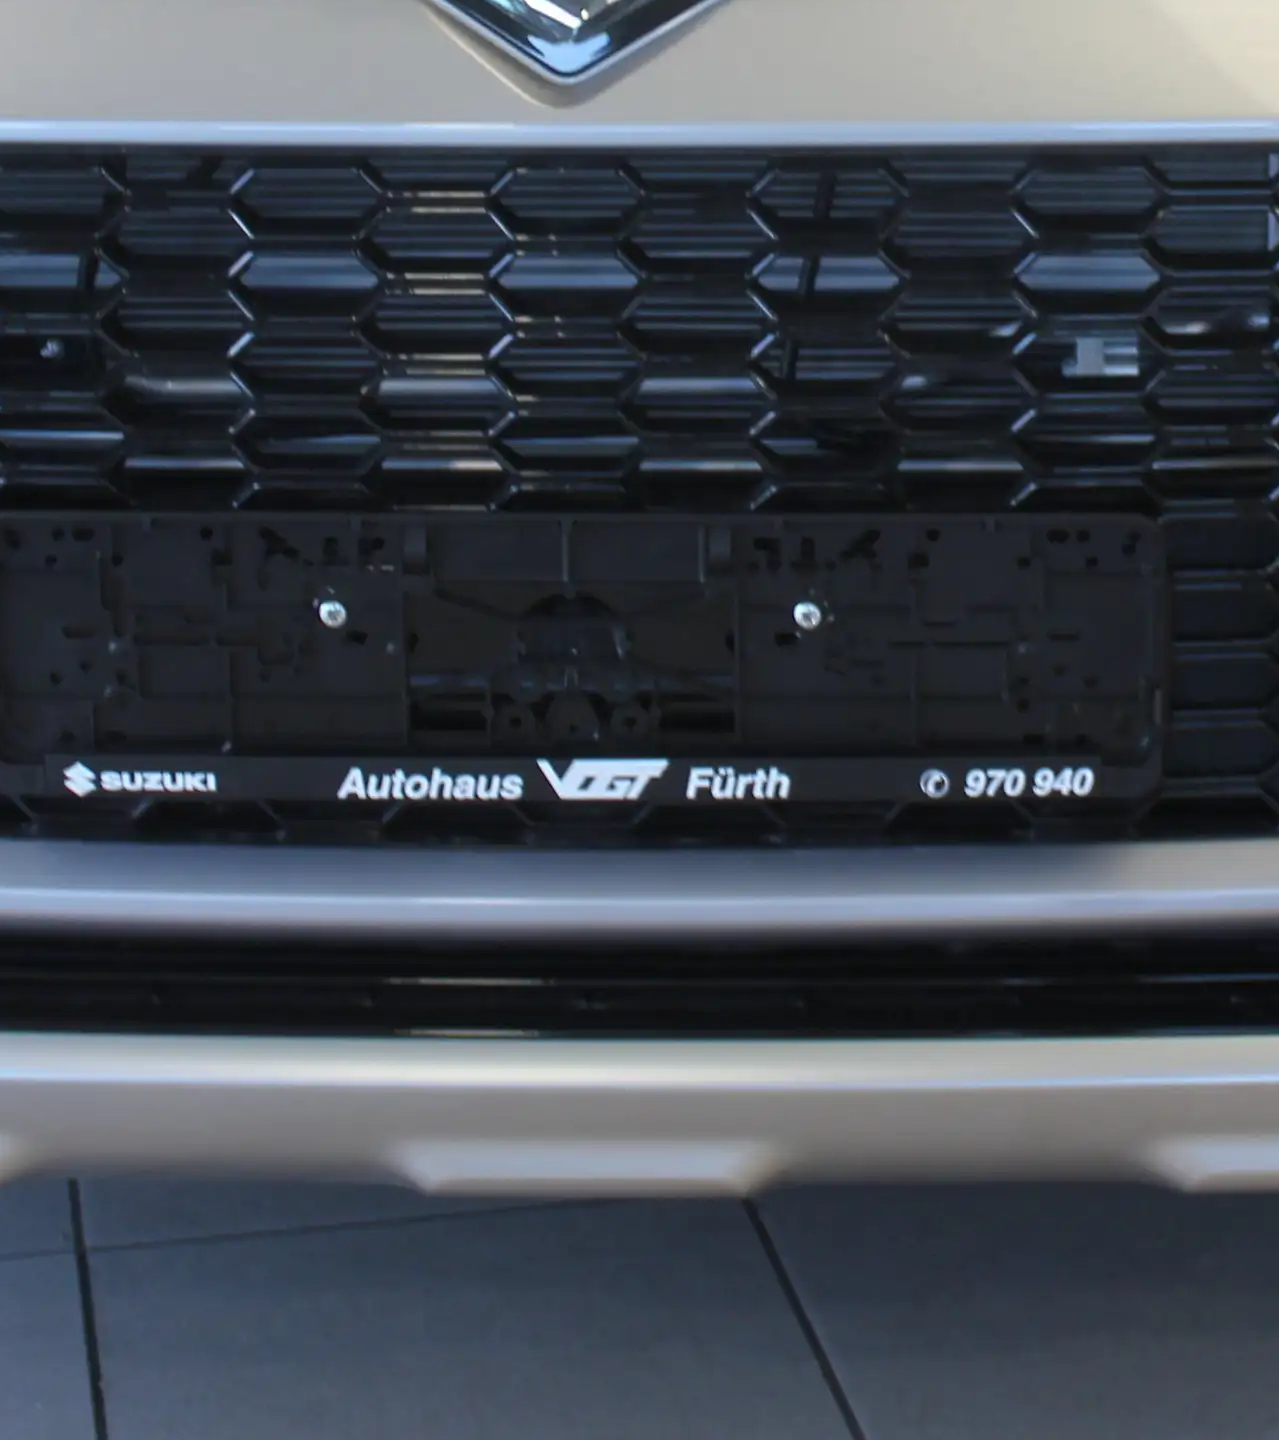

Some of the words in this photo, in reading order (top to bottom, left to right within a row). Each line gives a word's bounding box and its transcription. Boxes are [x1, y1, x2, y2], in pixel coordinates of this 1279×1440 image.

[100, 770, 216, 792] SUZUKI
[336, 767, 523, 800] Autohaus
[536, 758, 669, 800] VOGT
[685, 766, 790, 799] Fürth
[964, 768, 1025, 797] 970
[1032, 767, 1094, 796] 940
